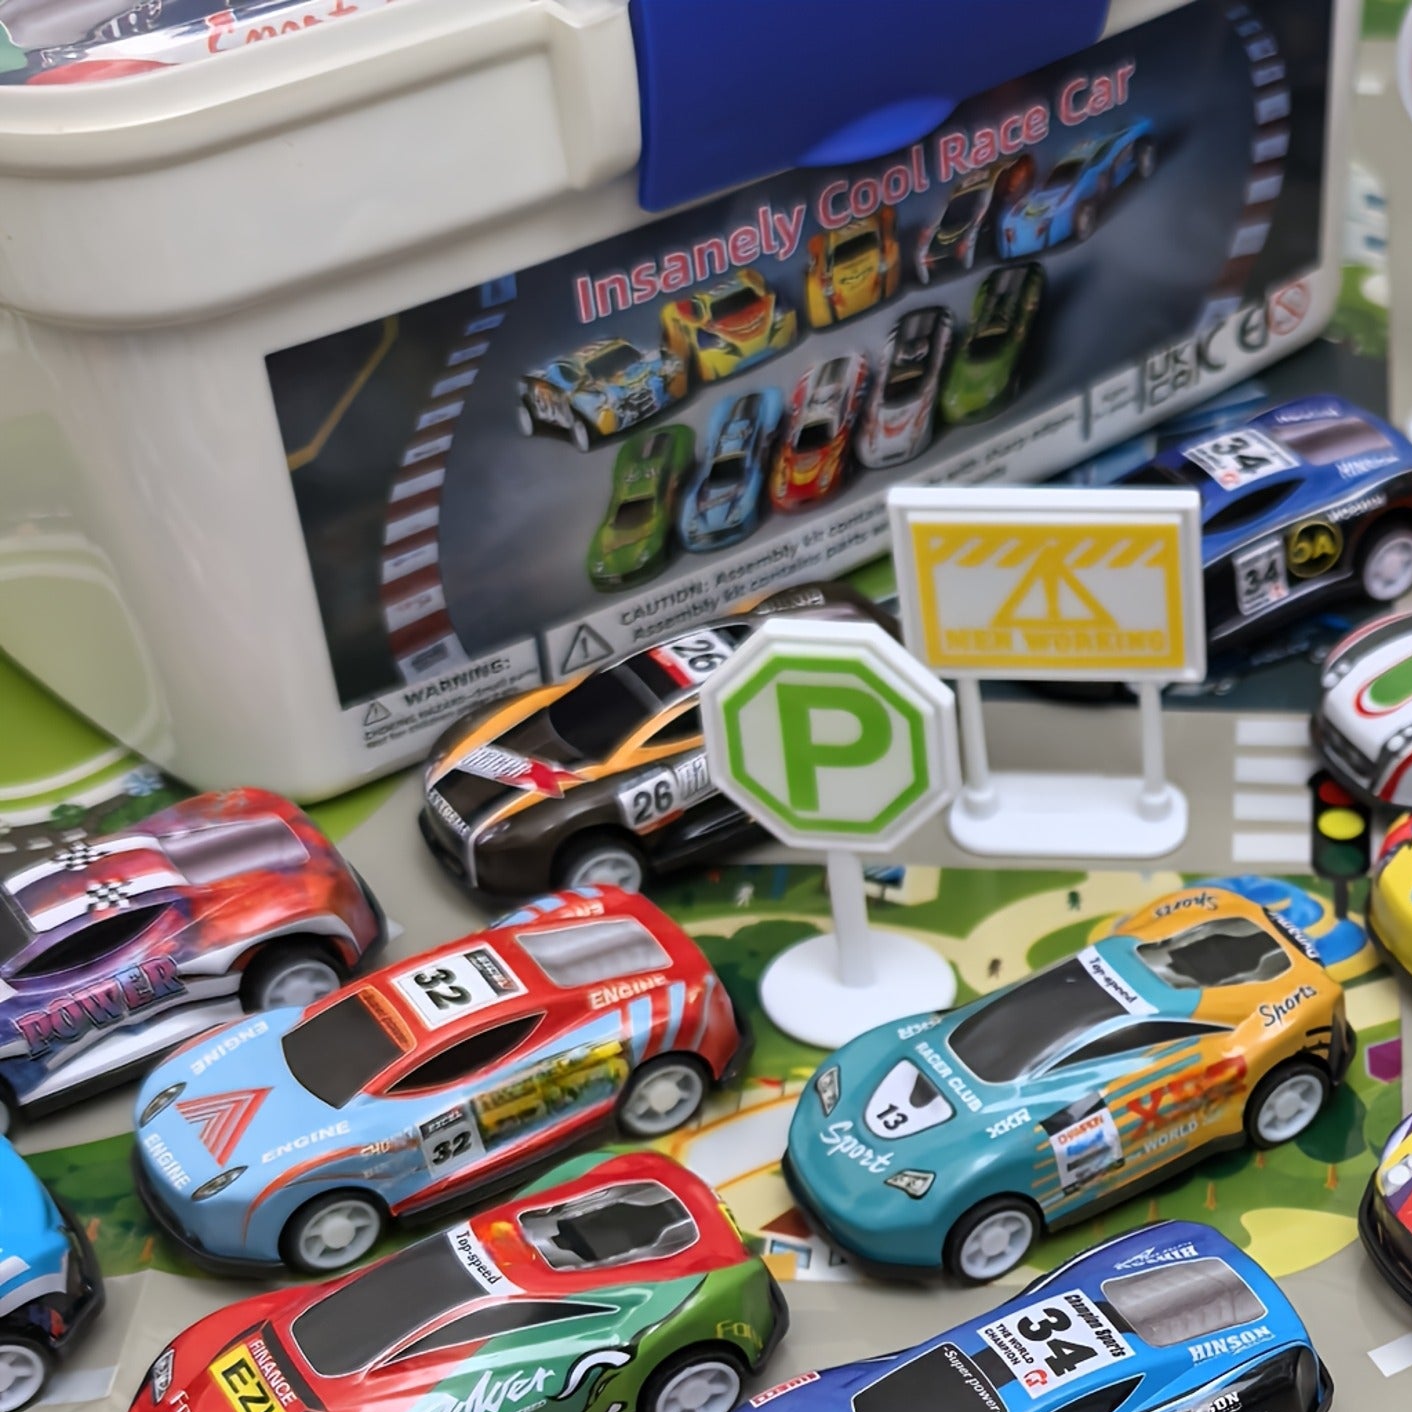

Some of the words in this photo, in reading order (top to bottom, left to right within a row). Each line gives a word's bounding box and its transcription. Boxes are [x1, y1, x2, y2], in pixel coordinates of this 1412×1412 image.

[576, 205, 806, 325] Insanely
[818, 145, 929, 230] Cool
[939, 104, 1050, 183] Race
[1059, 64, 1136, 128] Car
[674, 639, 722, 673] 26
[403, 659, 512, 707] WARNING:
[775, 682, 893, 812] P
[632, 780, 675, 824] 26
[413, 966, 474, 1011] 32
[588, 974, 669, 1011] ENGINE
[1089, 955, 1138, 1005] Top-speed
[8, 954, 190, 1061] POWER
[1257, 984, 1319, 1029] Sports
[190, 1020, 270, 1076] ENGINE
[948, 1074, 985, 1114] CLUB
[875, 1102, 910, 1132] 13
[985, 1107, 1033, 1140] XKR
[143, 1132, 193, 1190] ENGINE
[260, 1120, 351, 1164] ENGINE
[432, 1128, 475, 1166] 32
[818, 1119, 896, 1175] Sport
[455, 1230, 503, 1286] Top-speed
[983, 1326, 1022, 1366] CHAMPION
[995, 1323, 1011, 1342] THE
[1009, 1337, 1035, 1365] WORLD
[1016, 1307, 1099, 1378] 34
[1188, 1326, 1275, 1364] HINSON
[249, 1338, 299, 1407] FINANCE
